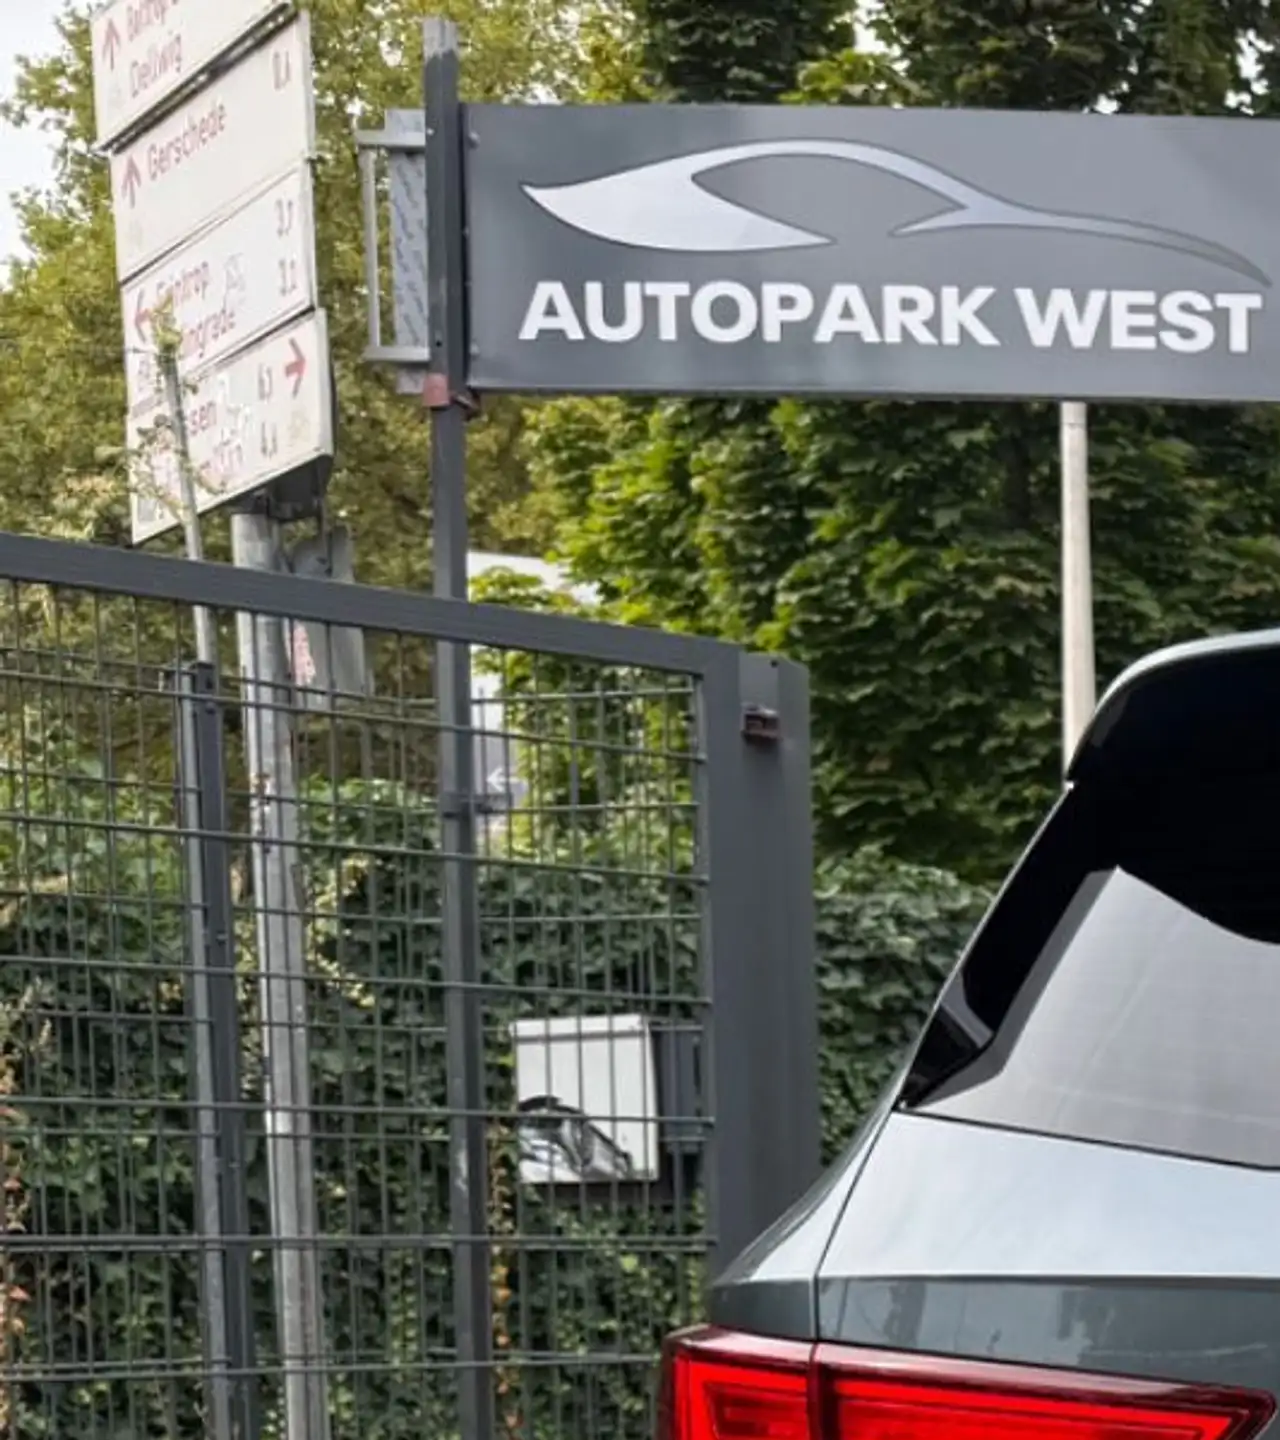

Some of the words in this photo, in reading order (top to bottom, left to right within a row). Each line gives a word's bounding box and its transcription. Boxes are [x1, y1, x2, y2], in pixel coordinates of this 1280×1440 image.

[150, 104, 226, 181] Gerschede
[517, 280, 1001, 347] AUTOPARK
[1014, 286, 1263, 354] WEST
